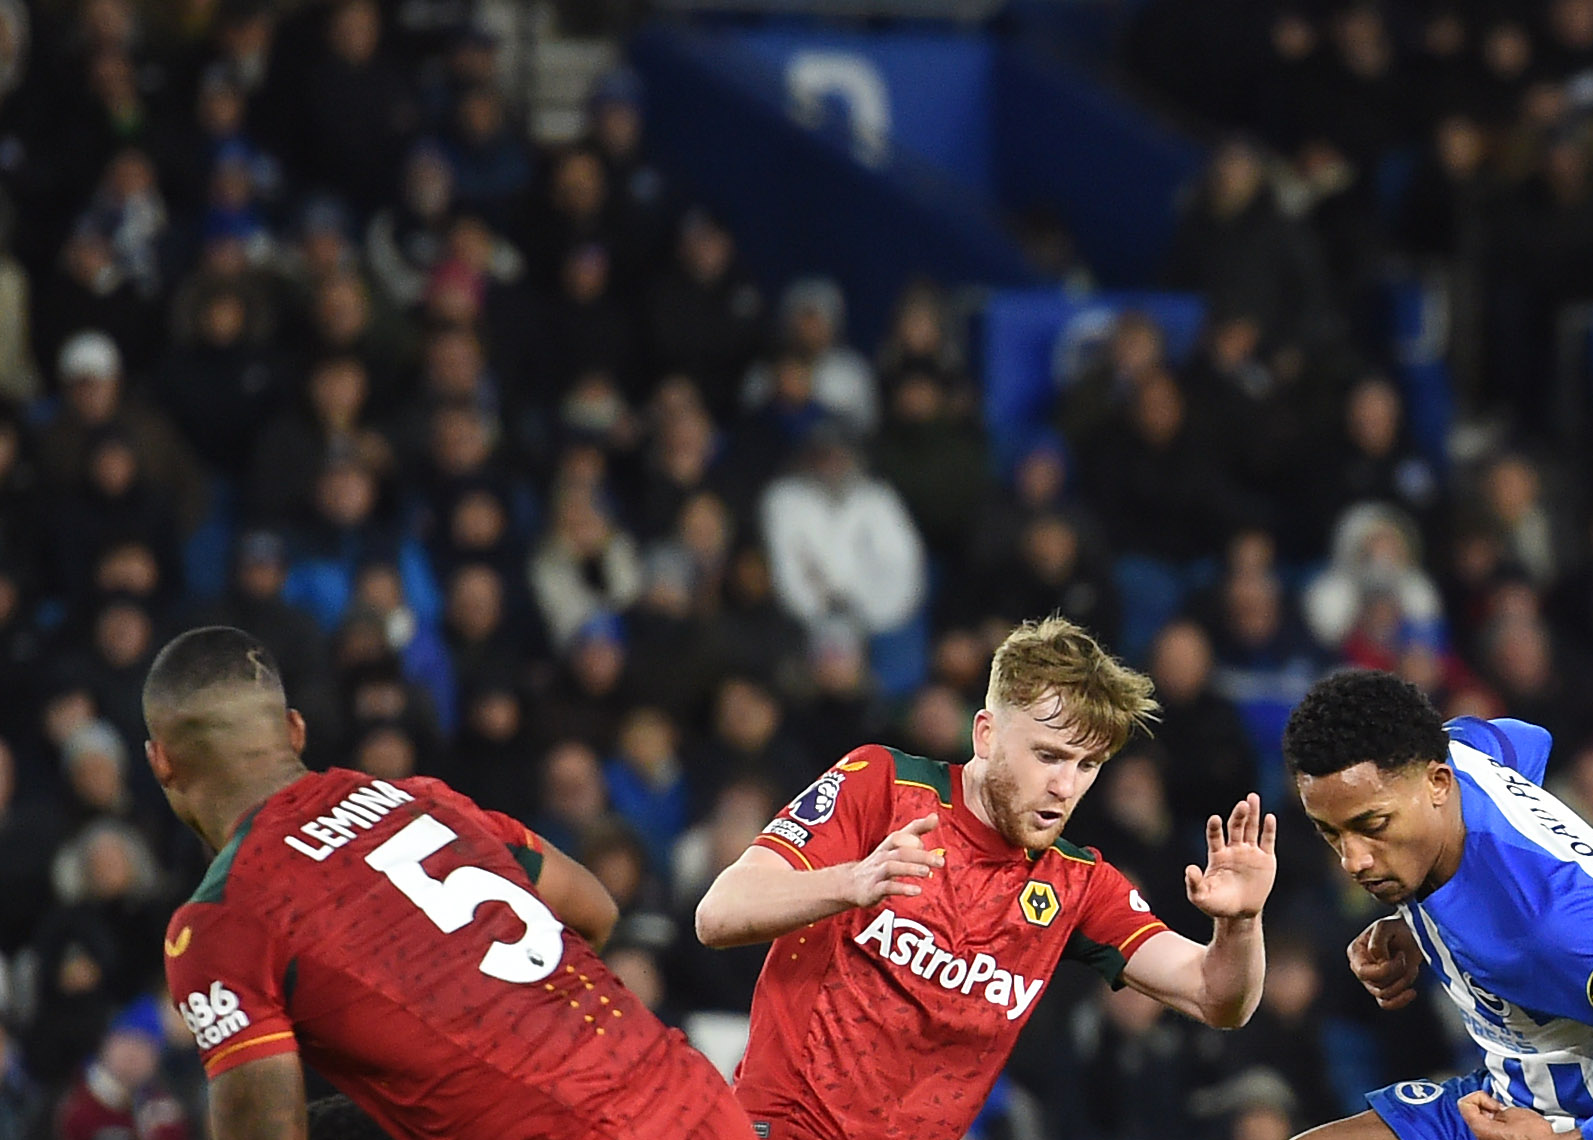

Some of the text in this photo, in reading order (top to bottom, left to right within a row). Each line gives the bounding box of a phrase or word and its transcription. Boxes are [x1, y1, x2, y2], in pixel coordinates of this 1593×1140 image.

[284, 780, 415, 861] LEMINA
[364, 813, 565, 984] 5
[854, 908, 1044, 1020] AstroPay
